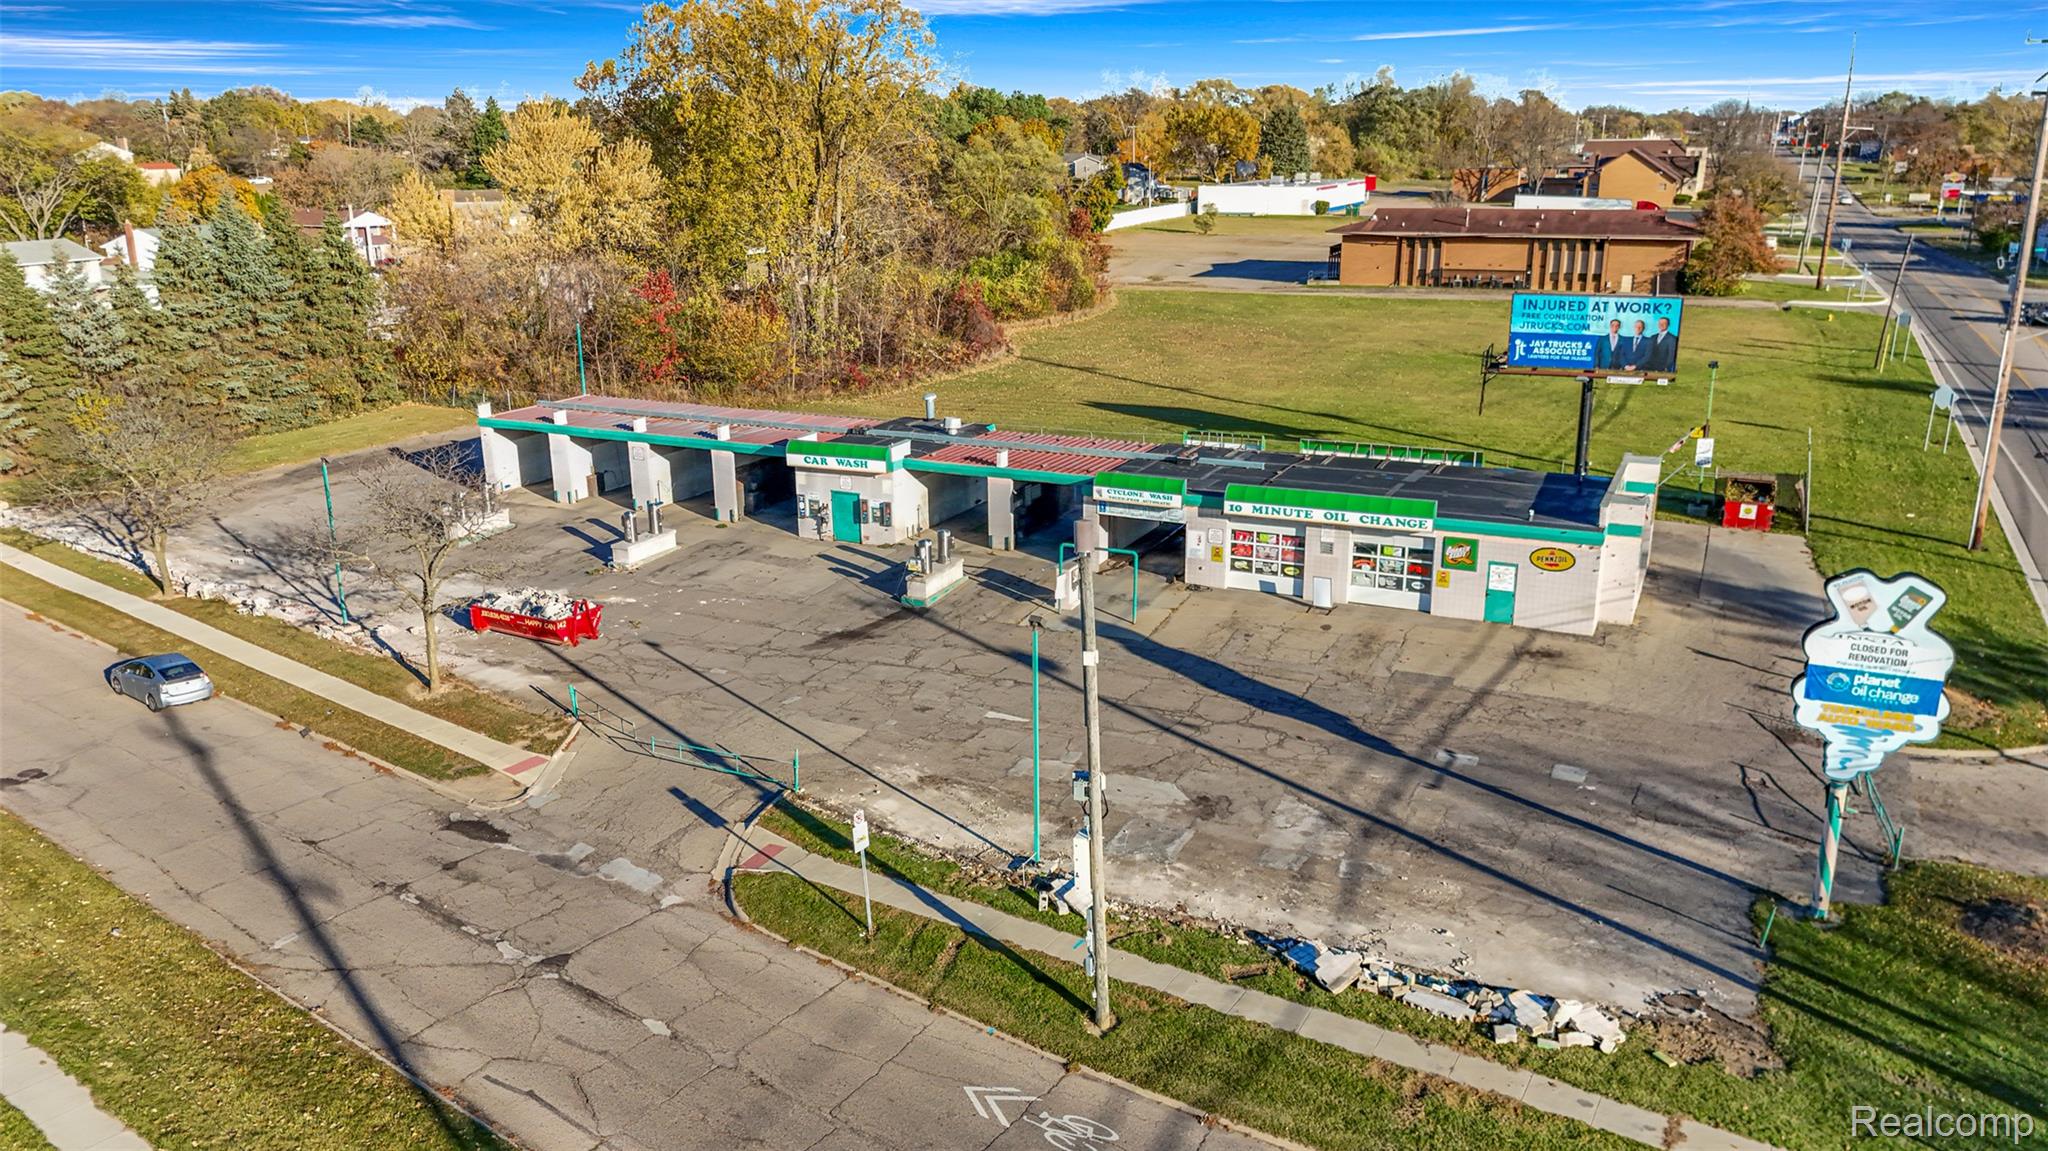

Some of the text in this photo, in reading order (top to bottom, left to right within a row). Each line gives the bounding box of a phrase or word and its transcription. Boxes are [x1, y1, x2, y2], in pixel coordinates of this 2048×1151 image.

[1523, 299, 1672, 315] INJURED AT WORK?
[1544, 313, 1604, 322] CONSULTATION
[1519, 322, 1591, 332] JTRUCKS.COM
[1529, 340, 1592, 350] JAY TRUCKS &
[1532, 347, 1588, 356] ASSOCIATES
[803, 456, 869, 469] CAR WASH
[1107, 489, 1173, 502] CYCLONE WASH
[1228, 504, 1429, 530] 10 MINUTE OIL CHANGE
[1536, 555, 1568, 563] PENNZOIL
[1850, 643, 1909, 657] CLOSED FOR
[1848, 653, 1908, 667] RENOVATION
[1853, 673, 1901, 689] planet
[1851, 686, 1919, 705] oil change
